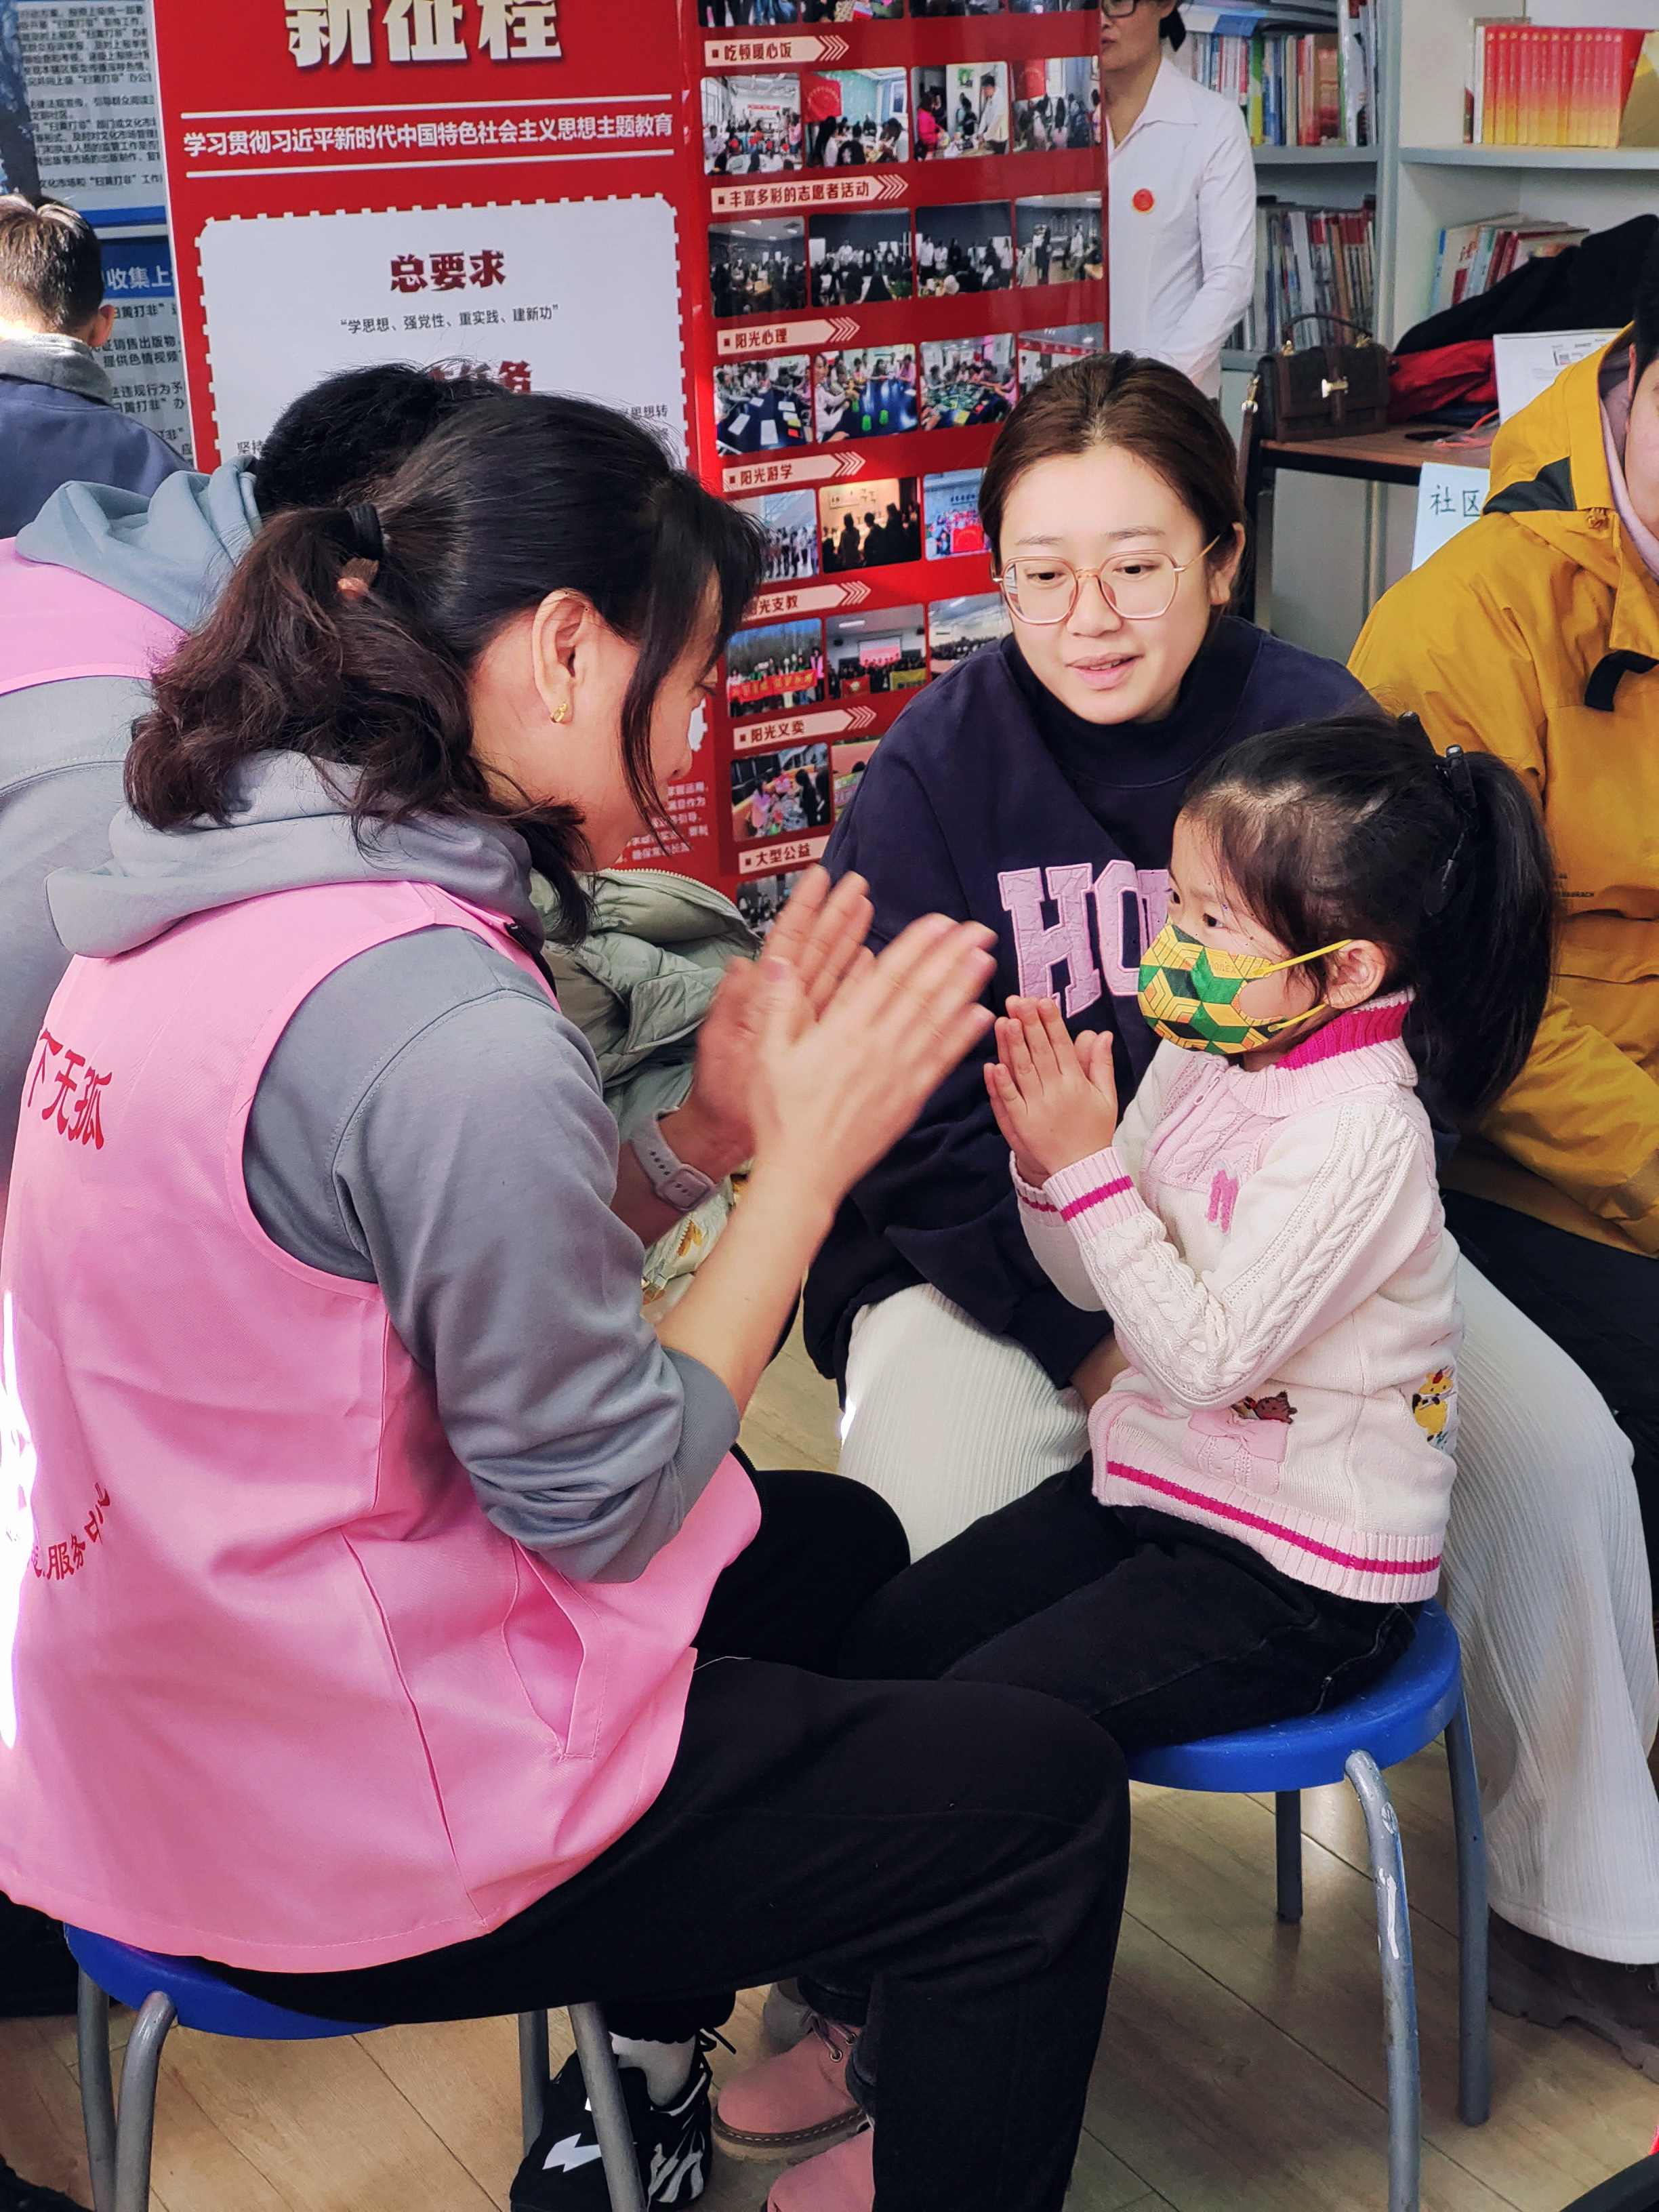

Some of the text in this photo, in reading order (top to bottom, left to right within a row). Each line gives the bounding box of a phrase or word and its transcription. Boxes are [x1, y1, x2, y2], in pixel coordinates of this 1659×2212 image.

[285, 0, 562, 67] 新征程
[724, 42, 792, 61] 吃顿暖心饭
[183, 113, 674, 157] 学习贯彻习近平新时代中国特色社会主义思想主题教育
[729, 180, 869, 208] 丰富多彩的志愿者活动
[104, 265, 172, 289] 收集上
[390, 249, 507, 293] 总要求
[340, 304, 559, 334] “学思想、强党性、重实践、建新功”
[735, 328, 788, 349] 阳光心理
[1429, 485, 1480, 517] 社区
[754, 594, 798, 615] 光支教
[751, 719, 805, 743] 阳光义卖
[756, 842, 811, 866] 大型公益
